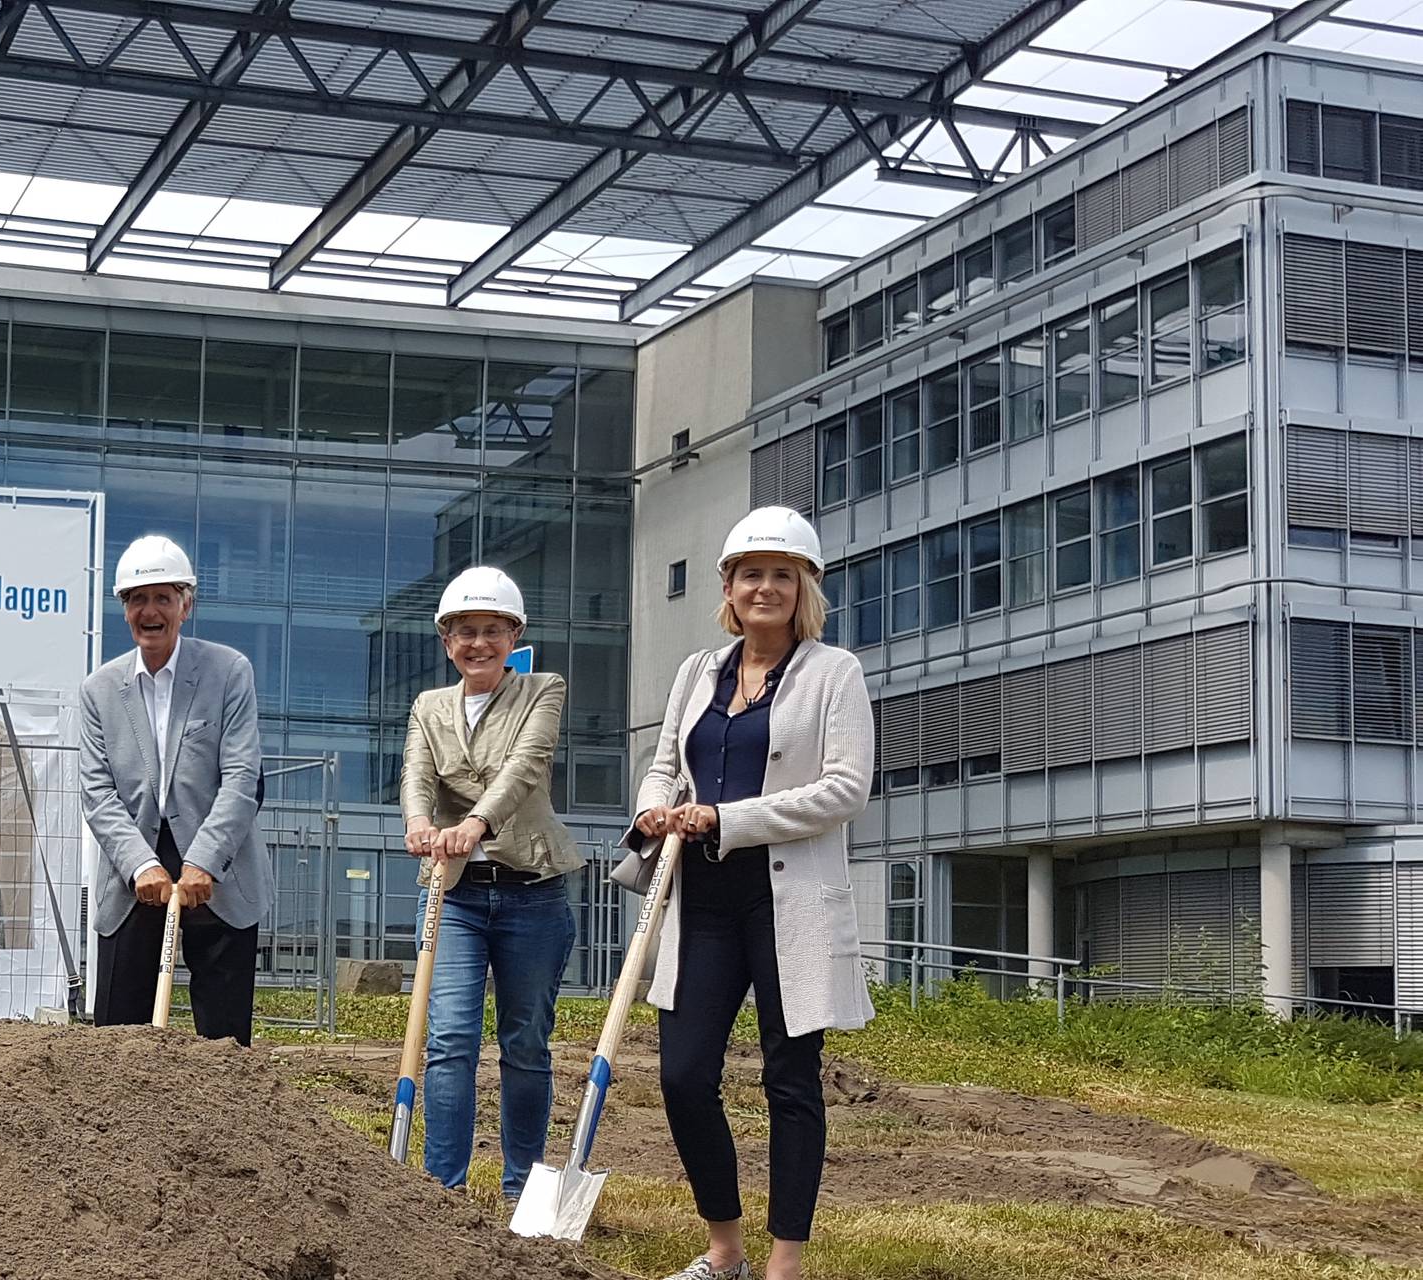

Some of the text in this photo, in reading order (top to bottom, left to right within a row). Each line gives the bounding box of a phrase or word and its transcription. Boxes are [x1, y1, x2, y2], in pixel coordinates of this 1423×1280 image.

[425, 874, 443, 939] GOLDBECK
[640, 855, 669, 920] GOLDBECK
[163, 911, 176, 963] GOLDBECK
